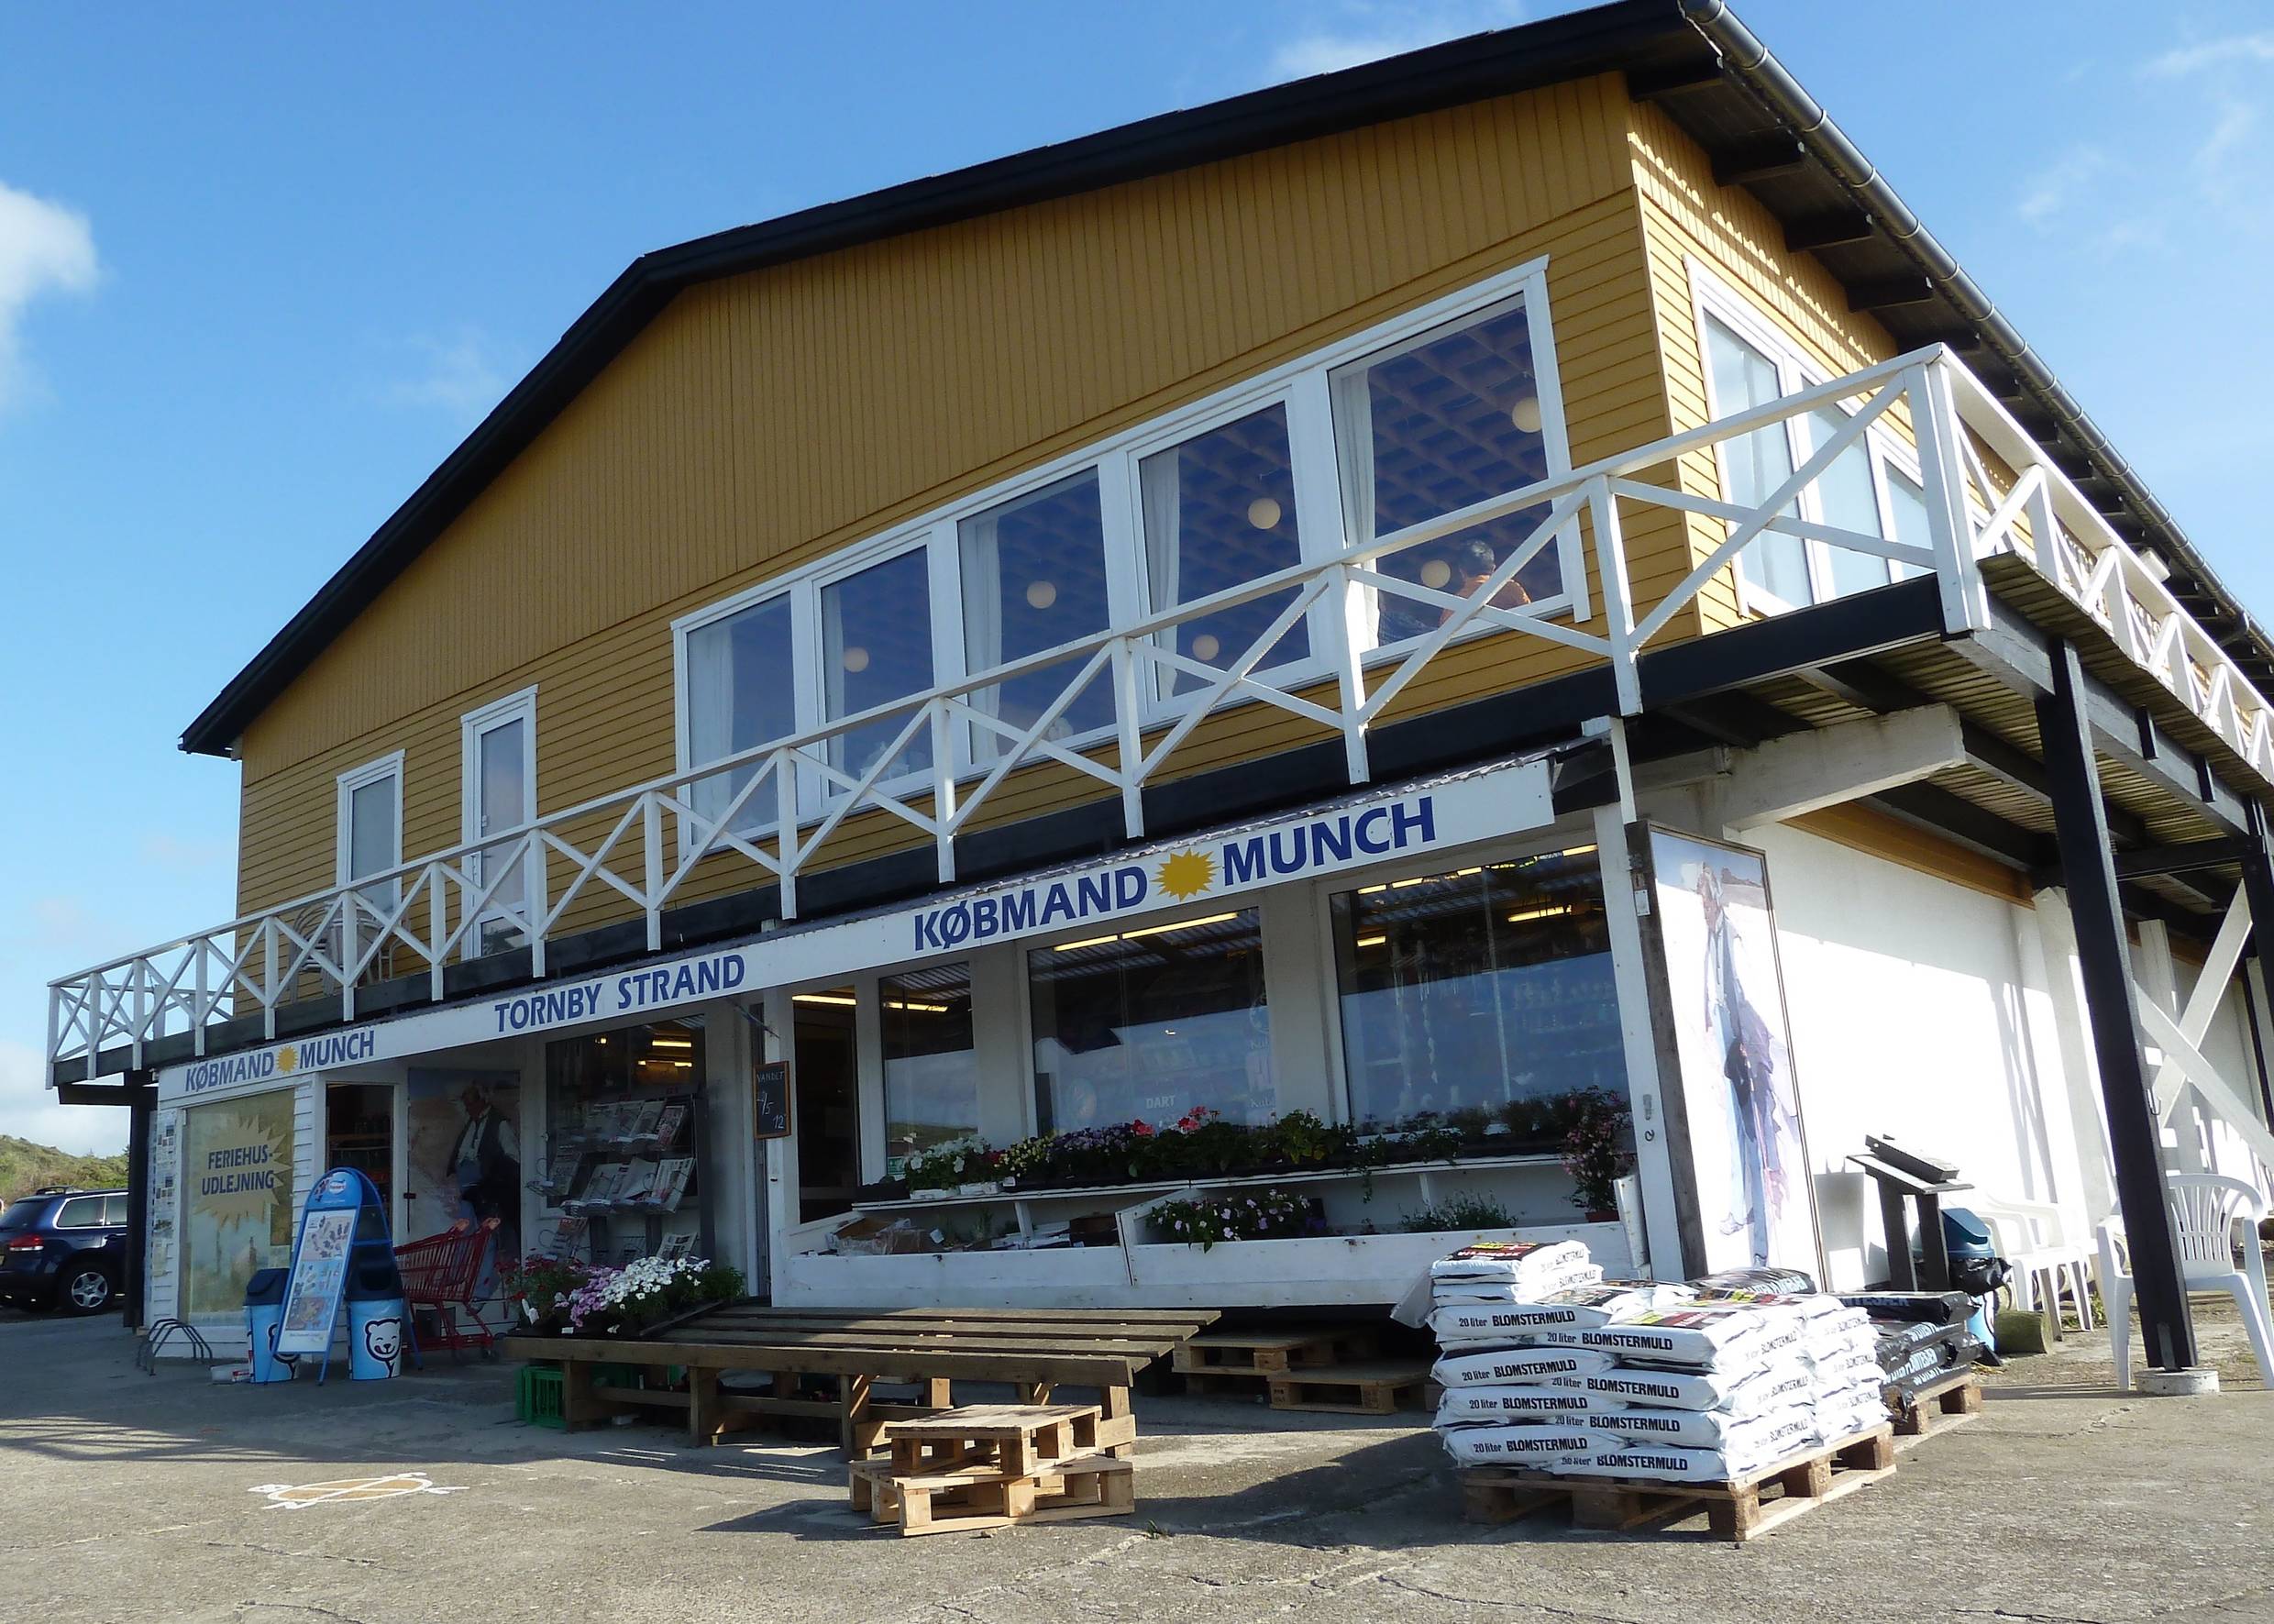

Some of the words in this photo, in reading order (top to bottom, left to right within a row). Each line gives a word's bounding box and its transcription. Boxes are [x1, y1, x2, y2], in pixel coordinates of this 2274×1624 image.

[914, 865, 1148, 951] KØBMAND
[1222, 796, 1436, 886] MUNCH
[494, 983, 602, 1033] TORNBY
[617, 954, 745, 1010] STRAND
[185, 1051, 274, 1092] KØBMAND
[299, 1030, 375, 1069] MUNCH
[208, 1144, 273, 1170] FERIEHUS-
[202, 1170, 274, 1196] UDLEJNING
[1471, 1318, 1487, 1327] liter
[1492, 1310, 1575, 1327] BLOMSTERMULD
[1559, 1332, 1576, 1343] liter
[1582, 1332, 1673, 1351] BLOMSTERMULD
[1474, 1370, 1490, 1380] liter
[1494, 1359, 1577, 1377] BLOMSTERMULD
[1563, 1377, 1582, 1388] liter
[1587, 1378, 1680, 1398] BLOMSTERMULD
[1481, 1399, 1497, 1409] liter
[1502, 1397, 1588, 1409] BLOMSTERMULD
[1566, 1416, 1584, 1427] liter
[1590, 1416, 1680, 1432] BLOMSTERMULD
[1485, 1442, 1502, 1453] liter
[1507, 1437, 1587, 1452] BLOMSTERMULD
[1596, 1455, 1688, 1471] BLOMSTERMULD
